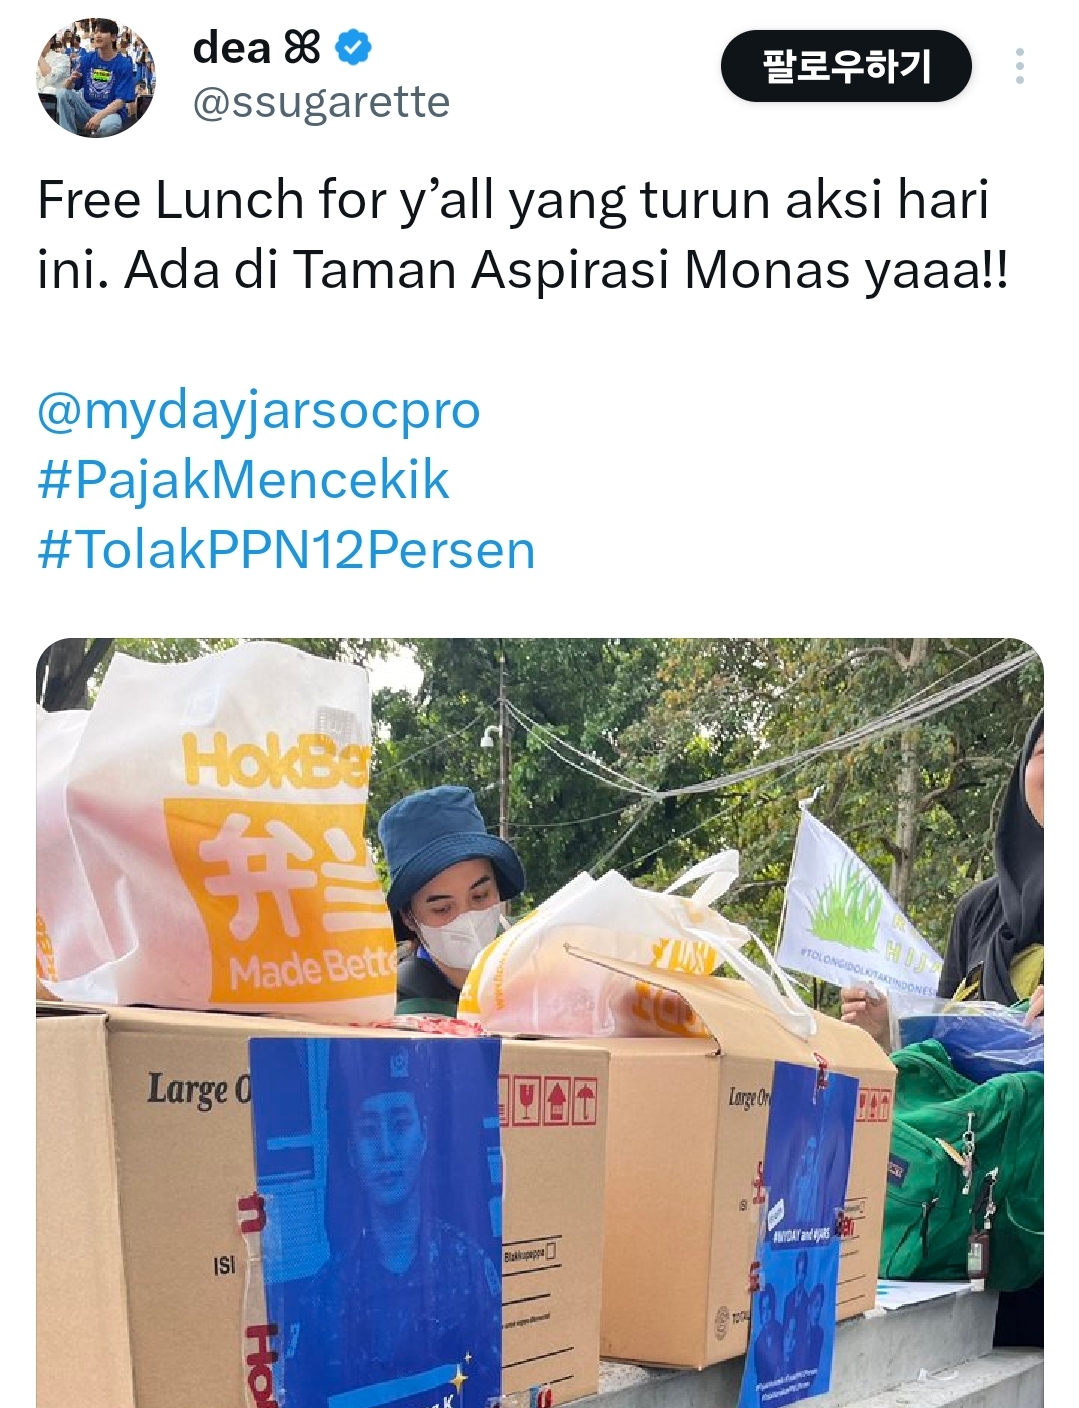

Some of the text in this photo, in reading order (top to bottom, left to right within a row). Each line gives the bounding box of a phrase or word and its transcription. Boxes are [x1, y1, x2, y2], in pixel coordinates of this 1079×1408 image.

[229, 952, 323, 991] Made
[147, 1071, 228, 1112] Large
[213, 1256, 236, 1276] ISI
